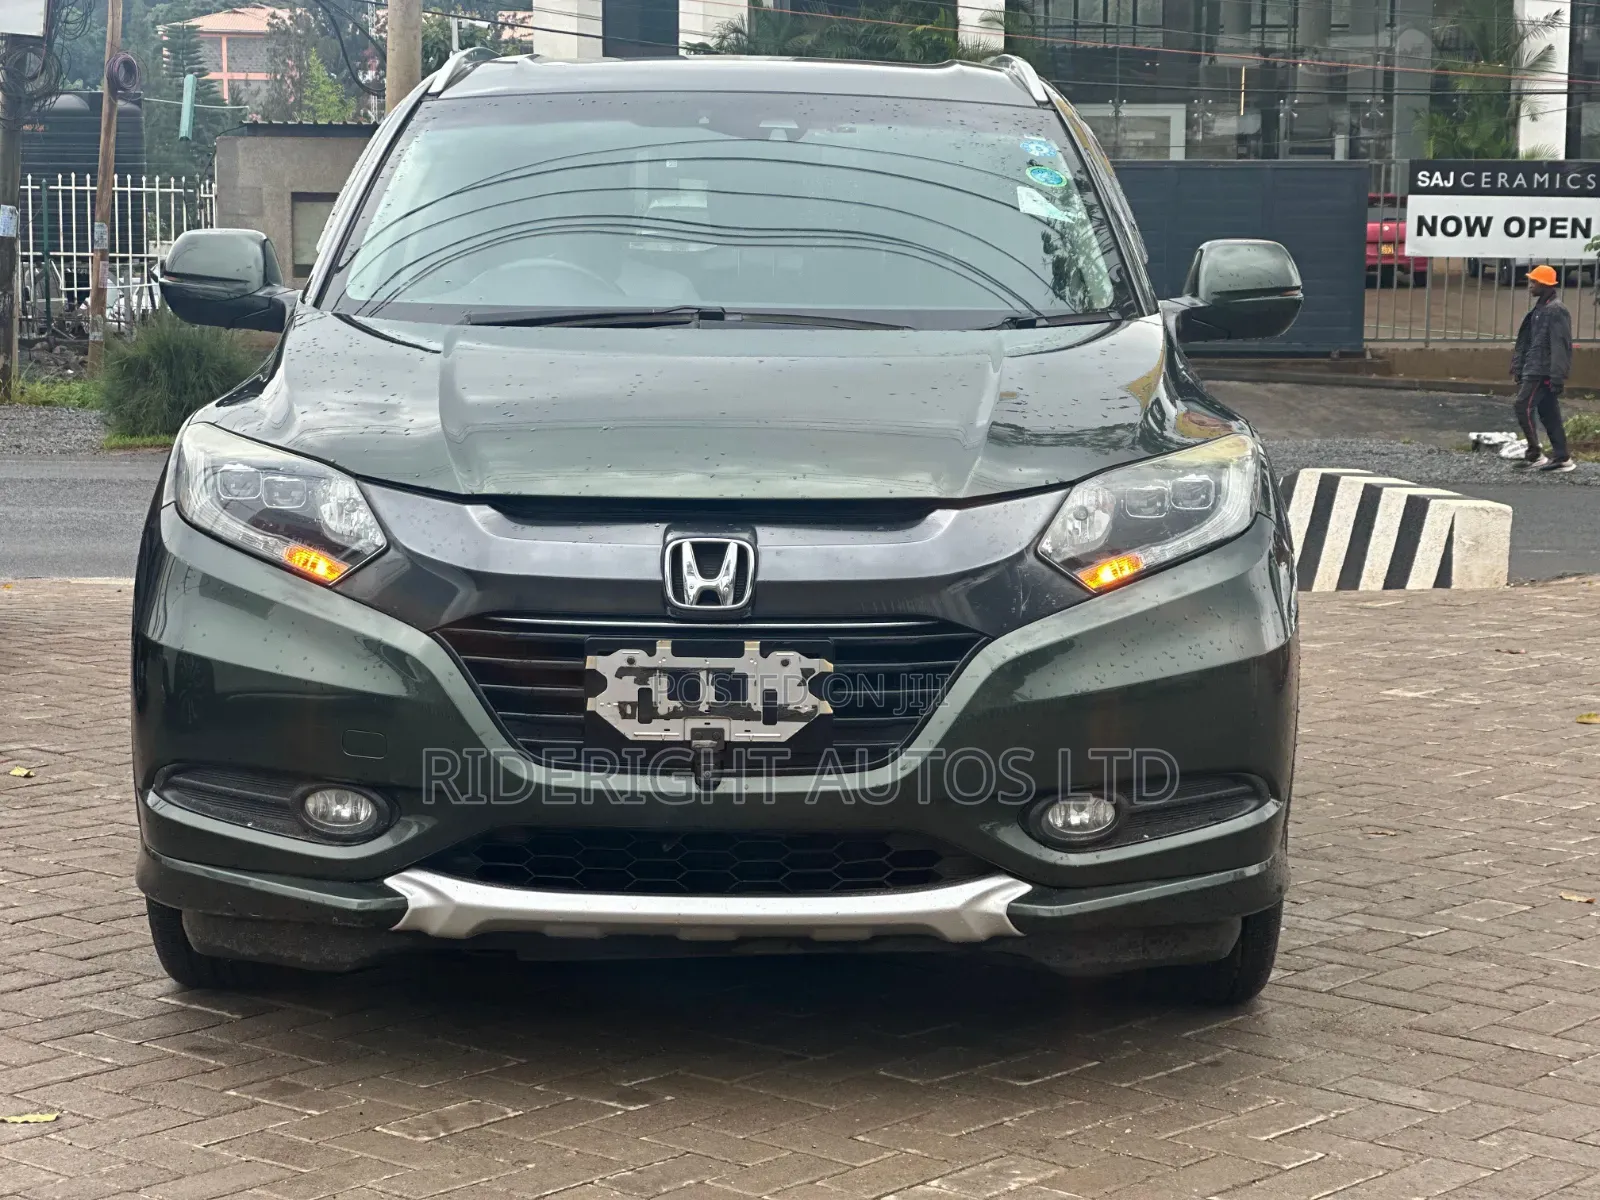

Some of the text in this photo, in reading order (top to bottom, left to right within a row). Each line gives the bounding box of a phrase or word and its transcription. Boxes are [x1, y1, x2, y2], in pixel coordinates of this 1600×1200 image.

[1416, 171, 1597, 190] SAJ CERAMICS
[1416, 215, 1593, 239] NOW OPEN
